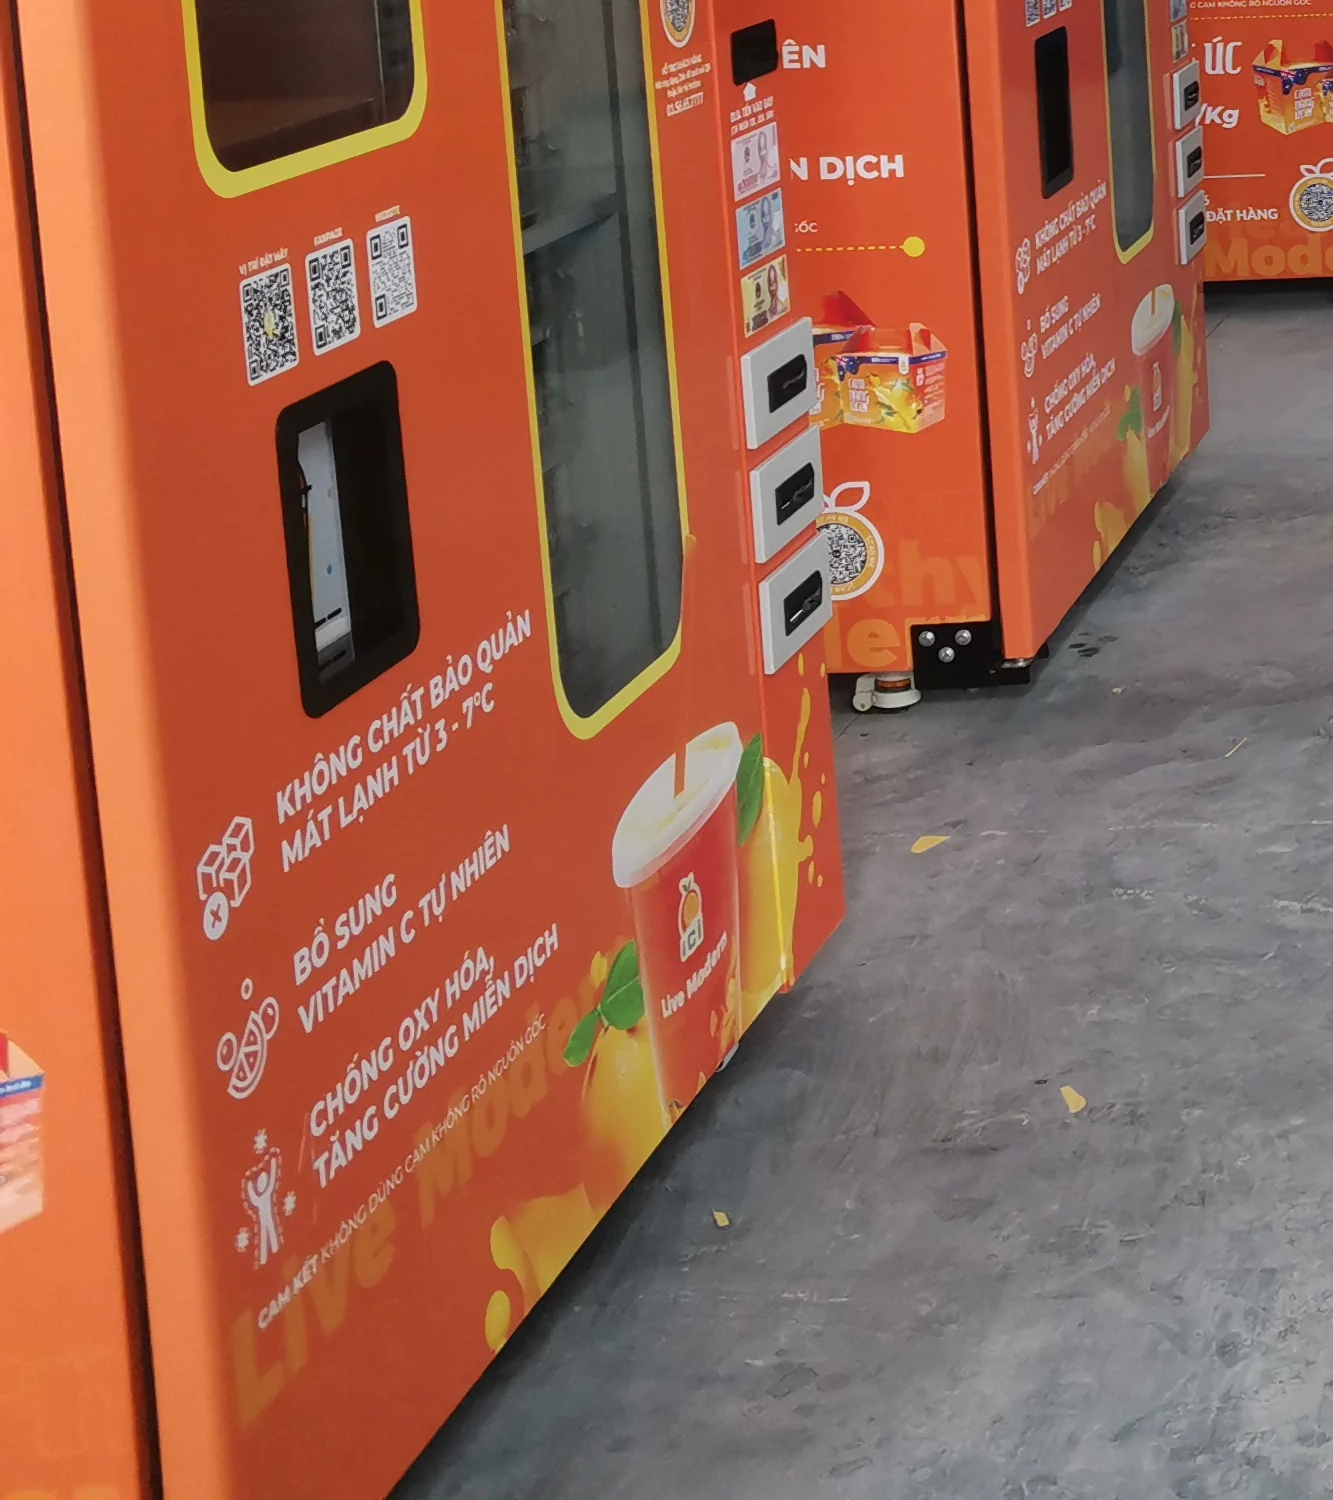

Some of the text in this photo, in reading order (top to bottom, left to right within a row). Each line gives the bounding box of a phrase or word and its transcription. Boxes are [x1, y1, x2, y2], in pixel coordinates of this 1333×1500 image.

[1203, 35, 1243, 75] ÚC
[820, 153, 905, 185] DỊCH
[1236, 207, 1278, 221] HÀNG
[274, 608, 533, 826] KHÔNG CHẤT BẢO QUẢN
[278, 682, 496, 874] MÁT LẠNH TỪ 3 7°C
[292, 873, 399, 986] BỔ SUNG
[296, 824, 511, 1036] VITAMIN C TỰ NHIÊN
[661, 930, 728, 1019] Live Modern
[308, 945, 496, 1138] CHỐNG OXY HÓA,
[311, 922, 560, 1190] TĂNG CƯỜNG MIỄN DỊCH
[257, 1292, 293, 1331] CAM
[290, 1253, 321, 1295] KẾT
[320, 1209, 368, 1267] KHÔNG
[367, 1166, 405, 1217] DÙNG
[403, 1138, 431, 1175] CAM
[429, 1095, 471, 1151] KHÔNG
[470, 1075, 489, 1104] RÕ
[487, 1035, 525, 1086] NGUỒN
